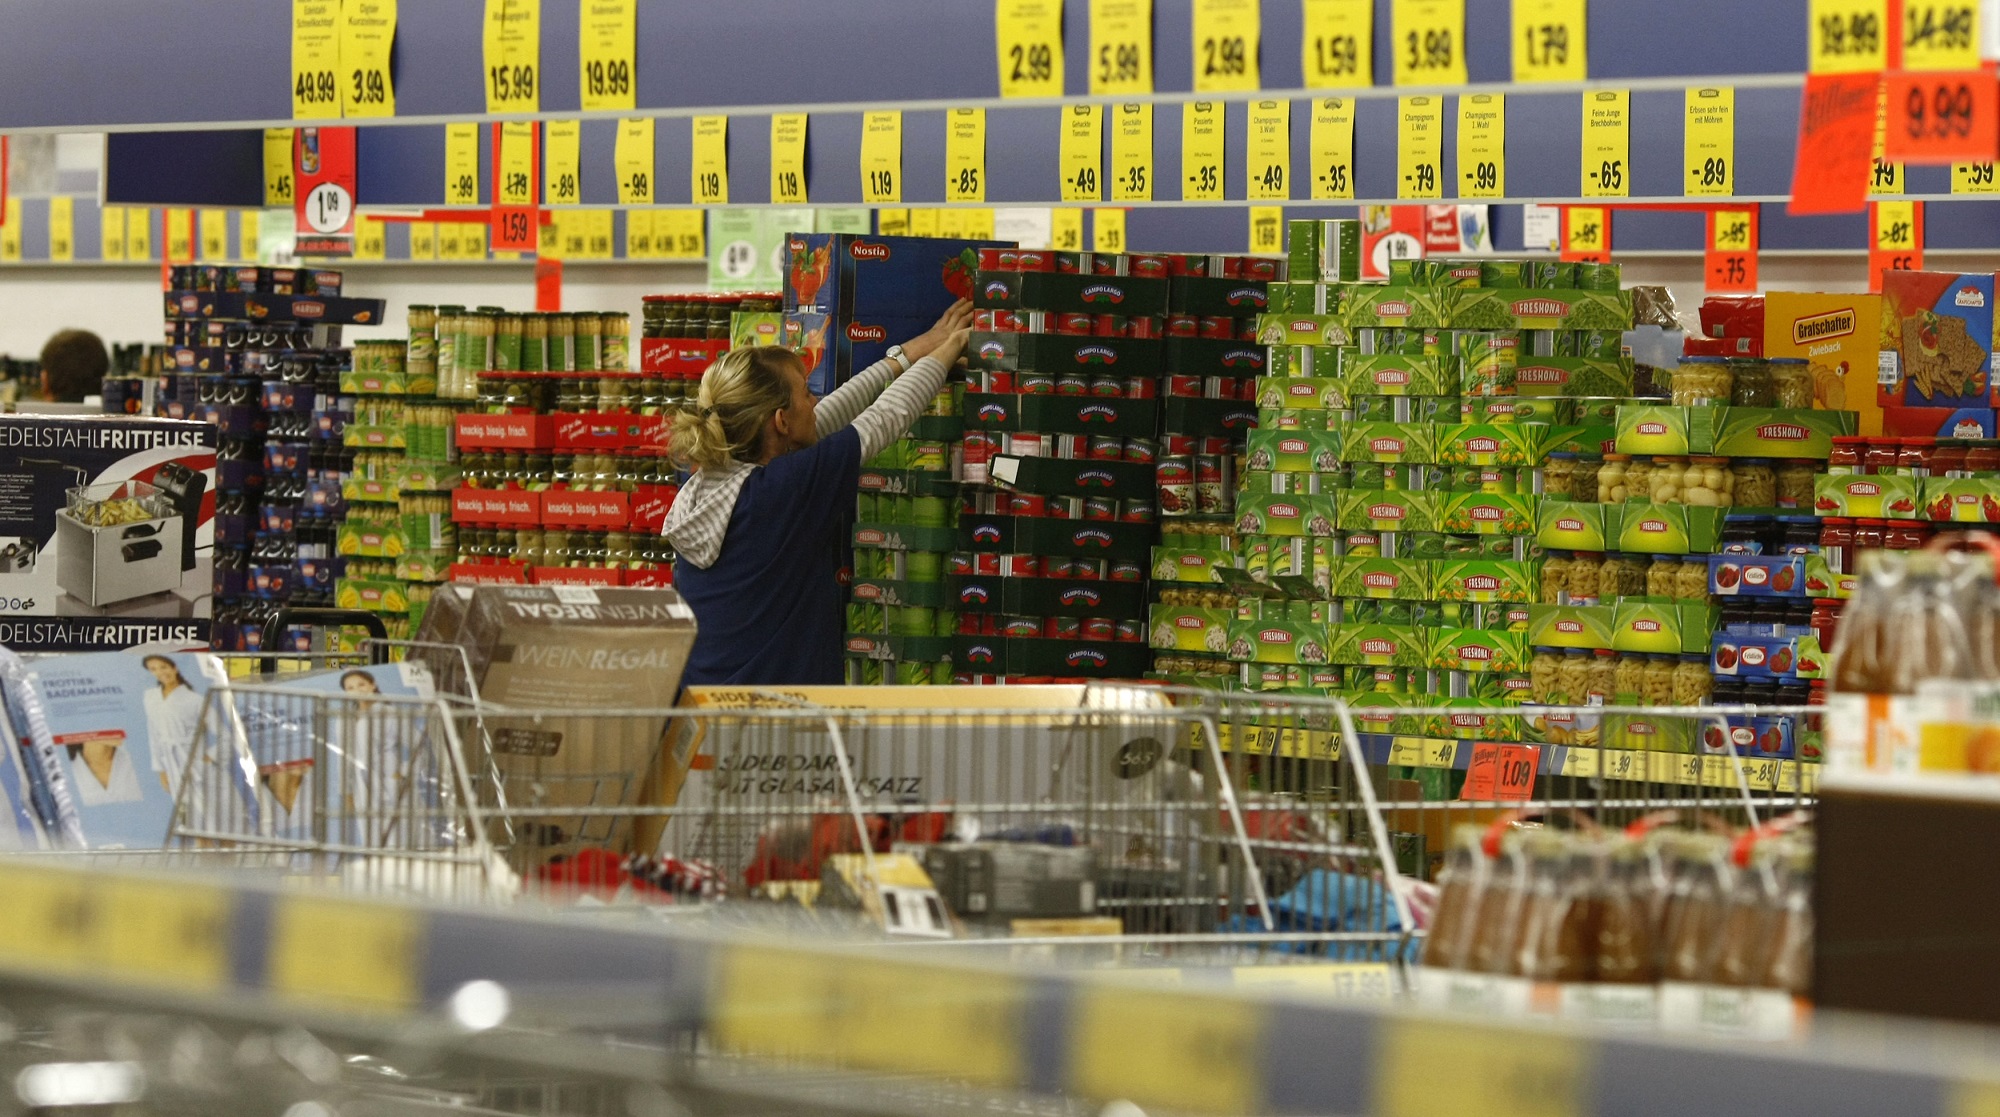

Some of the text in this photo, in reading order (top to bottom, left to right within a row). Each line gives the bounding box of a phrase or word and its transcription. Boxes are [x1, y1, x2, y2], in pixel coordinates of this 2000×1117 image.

[1407, 29, 1452, 70] 3.99
[1526, 24, 1568, 67] 1.79
[1204, 36, 1245, 76] 2.99
[1010, 44, 1050, 82] 2.99
[1099, 44, 1139, 82] 5.99
[491, 65, 533, 100] 15.99
[586, 59, 629, 96] 19.99
[295, 71, 335, 103] 49.99
[352, 69, 384, 104] 3.99
[1464, 111, 1497, 120] Champignons
[1592, 109, 1621, 118] Feine Junge
[1689, 105, 1729, 114] Erbsen sehr fein
[1906, 85, 1974, 139] 9.99
[1072, 120, 1091, 128] Gehackte
[1193, 117, 1214, 125] Passierte
[1253, 116, 1282, 126] Champignons
[1317, 116, 1348, 125] Kidneybohnen
[1404, 113, 1435, 122] Champignons
[1590, 119, 1622, 127] Brechbohnen
[1694, 115, 1723, 124] mit Möhren
[1194, 126, 1213, 134] Tomaten
[1411, 123, 1428, 132] 1.Wahl
[1471, 120, 1490, 129] 1.Wahl
[1072, 129, 1090, 137] Tomaten
[1123, 128, 1141, 136] Tomaten
[1254, 164, 1283, 192] -.49
[1318, 164, 1347, 192] -.35
[1405, 163, 1435, 192] -.79
[1465, 162, 1497, 190] -.99
[1590, 160, 1622, 190] -.65
[1692, 157, 1726, 186] -.89
[1870, 157, 1895, 187] .79
[1959, 160, 1994, 185] -.59
[551, 174, 574, 197] -.89
[623, 173, 647, 197] -.99
[700, 172, 719, 197] 1.19
[779, 172, 797, 196] 1.19
[870, 170, 892, 195] 1.19
[951, 168, 978, 194] -.85
[1067, 167, 1096, 193] -.49
[1119, 166, 1146, 193] -.35
[1189, 166, 1217, 192] -.35
[270, 175, 292, 198] -.45
[452, 175, 473, 197] -.99
[318, 191, 339, 225] 1.09
[502, 213, 527, 242] 1.59
[854, 246, 886, 257] Nostia
[1715, 257, 1746, 285] -.75
[1083, 286, 1122, 298] CAMPO LARGO
[1230, 290, 1266, 301] CAMPO LARGO
[1380, 304, 1408, 316] FRESHONA
[1518, 302, 1562, 316] FRESHONA
[850, 328, 882, 338] Nostia
[1293, 322, 1315, 332] FRESHONA
[1797, 314, 1852, 339] Grafschafter
[1078, 347, 1115, 358] CAMPO LARGO
[1808, 341, 1841, 357] Zwieback
[1224, 352, 1261, 362] CAMPO LARGO
[1377, 371, 1406, 384] FRESHONA
[1517, 370, 1561, 383] FRESHONA
[1293, 386, 1313, 396] FRESHONA
[1080, 406, 1115, 417] CAMPO LARGO
[1641, 424, 1663, 434] FRESHONA
[1763, 426, 1803, 439] FRESHONA
[0, 426, 204, 449] EDELSTAHLFRITTEUSE
[1282, 441, 1304, 452] FRESHONA
[1374, 438, 1400, 451] FRESHONA
[1468, 438, 1496, 452] FRESHONA
[1078, 471, 1113, 482] CAMPO LARGO
[1850, 484, 1875, 495] FRESHONA
[509, 500, 531, 512] frisch.
[548, 503, 574, 516] knackig.
[575, 503, 598, 517] bissig.
[599, 503, 621, 515] frisch.
[1272, 506, 1296, 517] FRESHONA
[1371, 504, 1401, 518] FRESHONA
[1472, 506, 1499, 520] FRESHONA
[1559, 520, 1581, 530] FRESHONA
[1642, 522, 1664, 531] FRESHONA
[1075, 530, 1110, 541] CAMPO LARGO
[1183, 555, 1203, 565] FRESHONA
[1367, 576, 1394, 586] FRESHONA
[1468, 576, 1496, 589] FRESHONA
[1063, 589, 1098, 600] CAMPO LARGO
[507, 601, 671, 620] WEINREGAL
[1178, 618, 1201, 628] FRESHONA
[1558, 622, 1580, 632] FRESHONA
[1636, 621, 1657, 631] FRESHONA
[0, 624, 198, 646] DELSTAHLFRITTEUSE
[1264, 631, 1287, 643] FRESHONA
[1365, 642, 1393, 654] FRESHONA
[1461, 648, 1489, 660] FRESHONA
[518, 644, 671, 670] WEINREGAL
[1068, 649, 1104, 661] CAMPO LARGO
[46, 685, 124, 700] BADEMANTEL
[1432, 744, 1453, 762] -.49
[1611, 755, 1631, 773] -.39
[1501, 760, 1532, 788] 1.09
[1752, 763, 1775, 782] -.85
